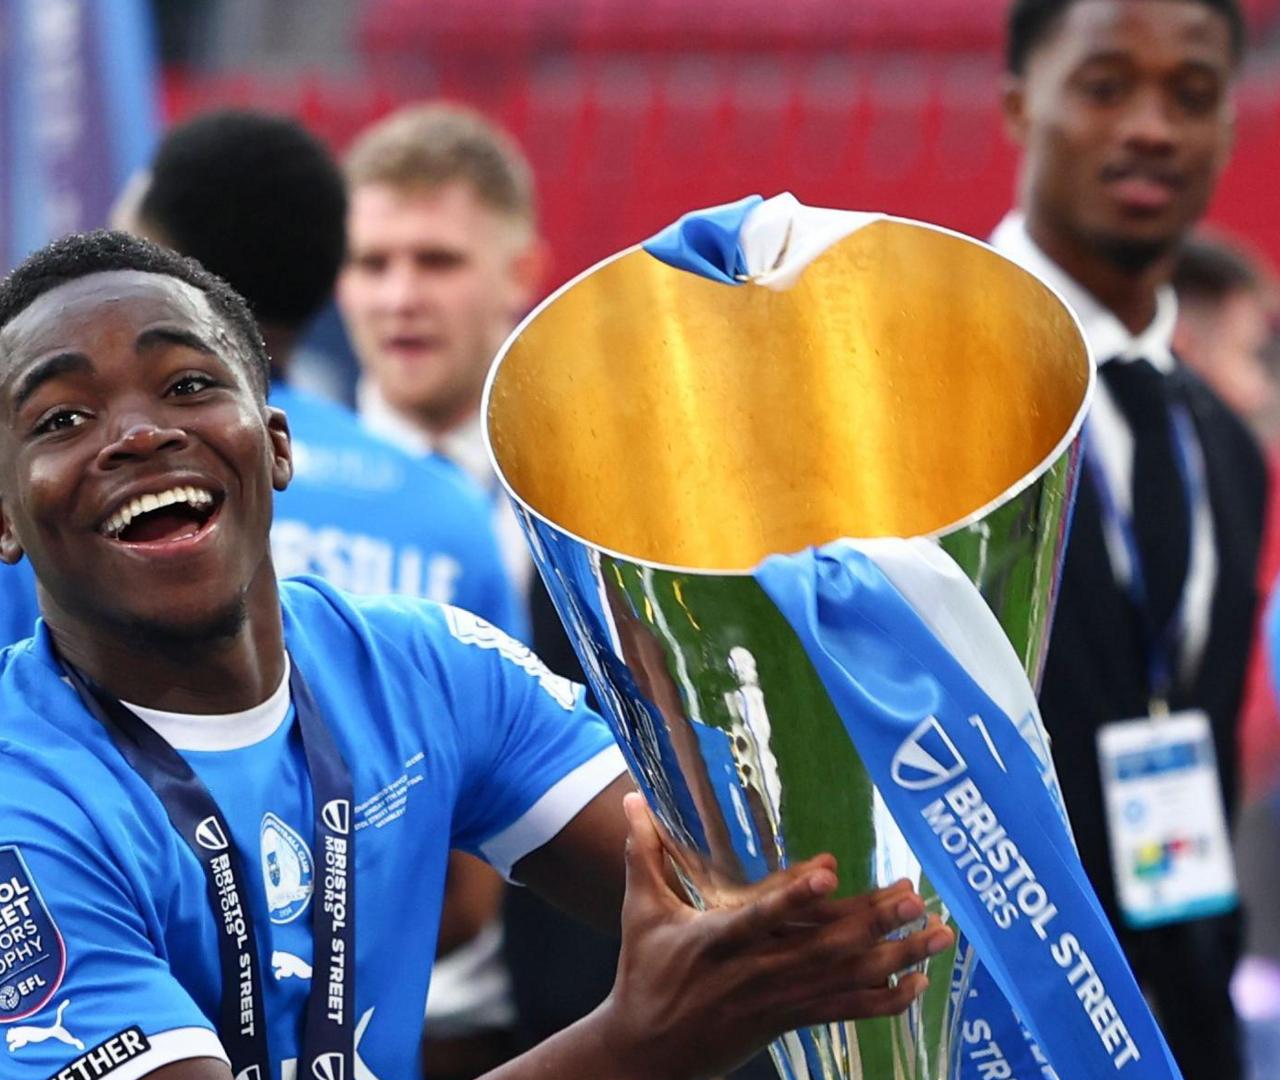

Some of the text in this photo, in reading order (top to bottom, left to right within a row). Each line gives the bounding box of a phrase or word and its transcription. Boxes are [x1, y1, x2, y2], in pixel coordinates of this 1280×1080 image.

[210, 858, 236, 936] MOTORS
[324, 835, 335, 913] MOTORS
[921, 798, 1019, 930] MOTORS
[945, 778, 1058, 941] BRISTOL
[1051, 932, 1141, 1071] STREET
[18, 973, 46, 996] EFL
[218, 853, 255, 1037] BRISTOL STREET
[327, 838, 348, 1025] BRISTOL STREET
